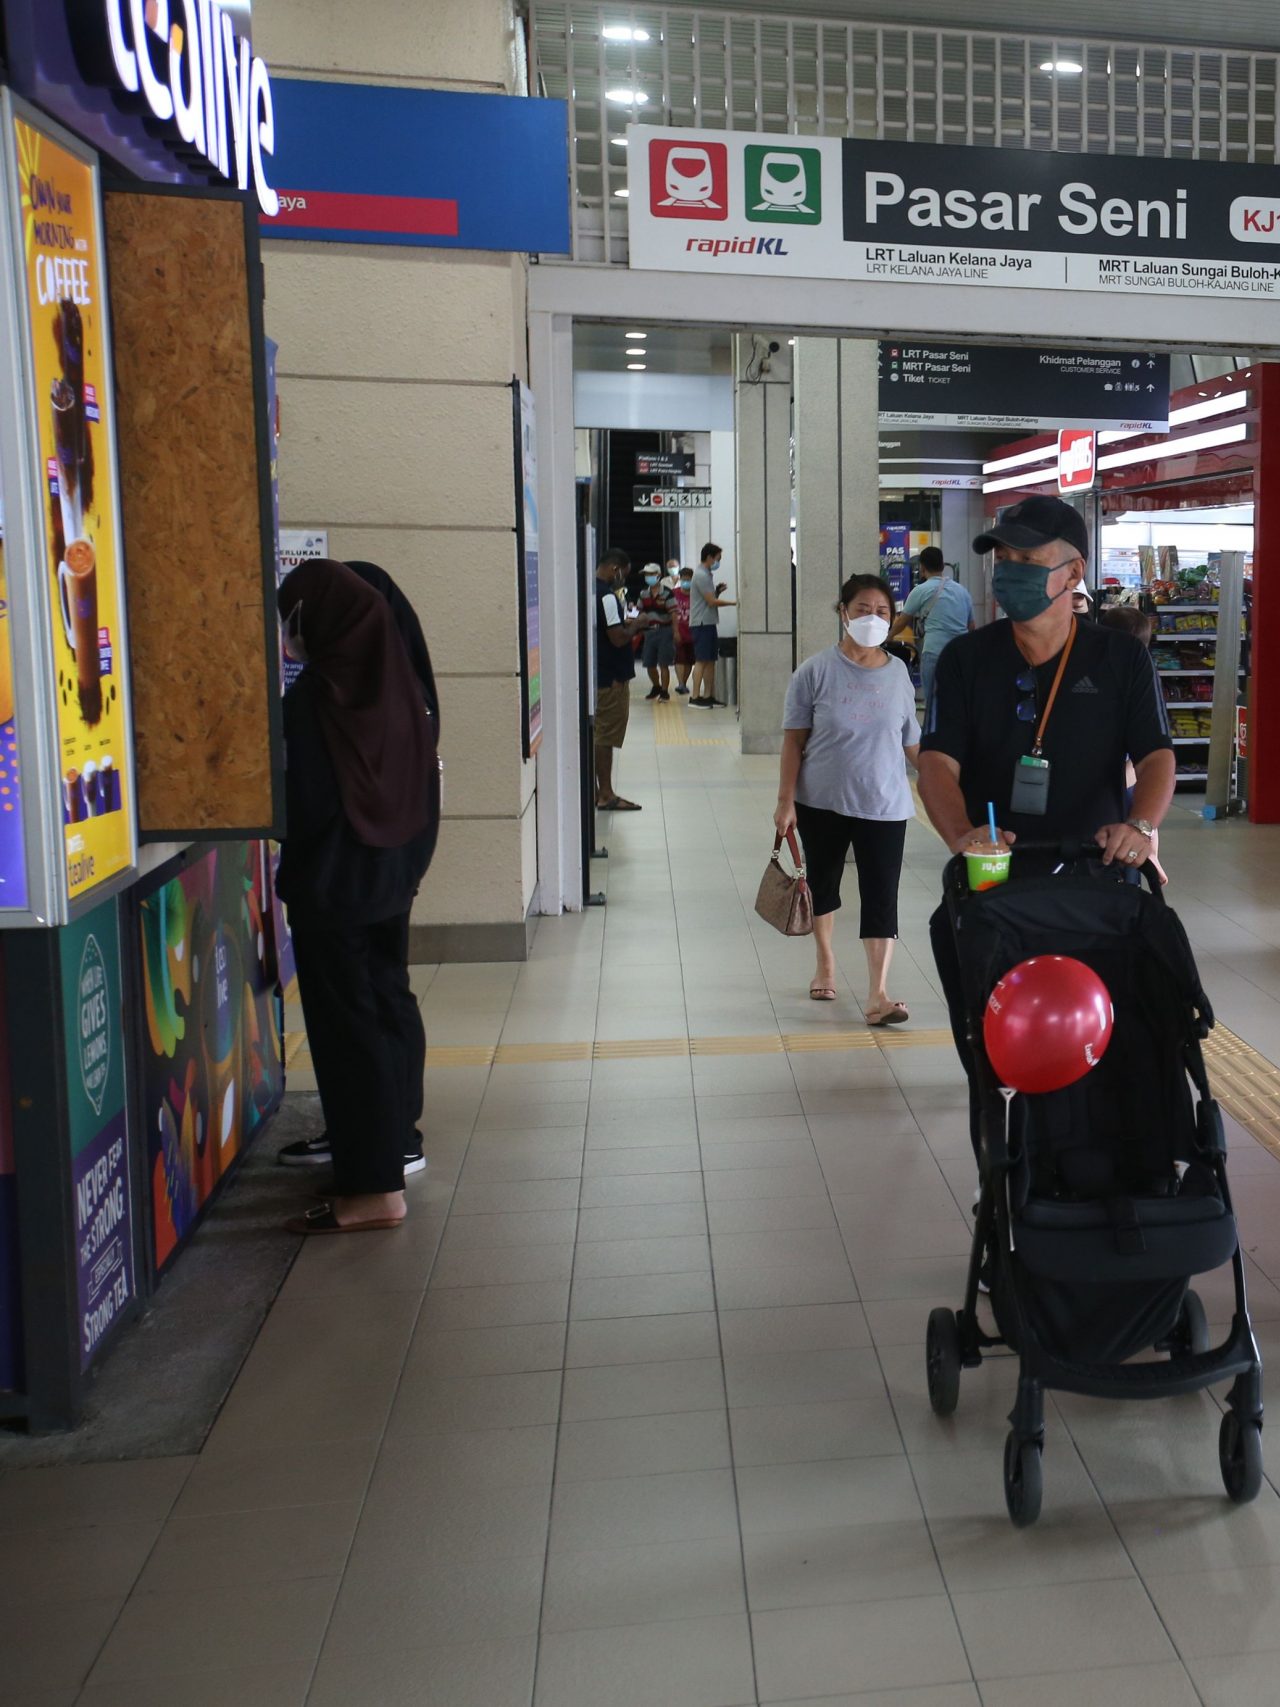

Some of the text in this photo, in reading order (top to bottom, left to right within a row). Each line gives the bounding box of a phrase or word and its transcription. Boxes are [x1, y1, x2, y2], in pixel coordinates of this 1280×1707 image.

[278, 195, 307, 211] aya
[865, 170, 1042, 232] Pasar
[1057, 182, 1187, 239] Seni
[686, 237, 789, 257] rapidKL
[866, 248, 1032, 269] LRT Laluan Kelana Jaya
[866, 263, 988, 279] LRT KELANA JAYA LINE
[1099, 259, 1130, 273] MRT
[1133, 261, 1178, 276] Laluan
[1181, 263, 1228, 280] Sungai
[36, 254, 91, 305] COFFEE
[1099, 274, 1274, 293] MRT SUNGAI BULOH-KAJANG LINE
[902, 349, 969, 361] LRT Pasar Seni
[1040, 355, 1121, 369] Khidmat Pelanggan
[902, 361, 971, 373] MRT Pasar Seni
[1061, 366, 1094, 374] CUSTOMER
[903, 373, 924, 383] Tiket
[1120, 422, 1153, 430] rapidKL
[886, 547, 905, 555] PAS
[281, 557, 305, 567] TUA
[81, 989, 106, 1039] GIVES
[77, 1154, 108, 1230] NEVER
[80, 1233, 91, 1267] THE
[84, 1266, 129, 1353] STRONG TEA
